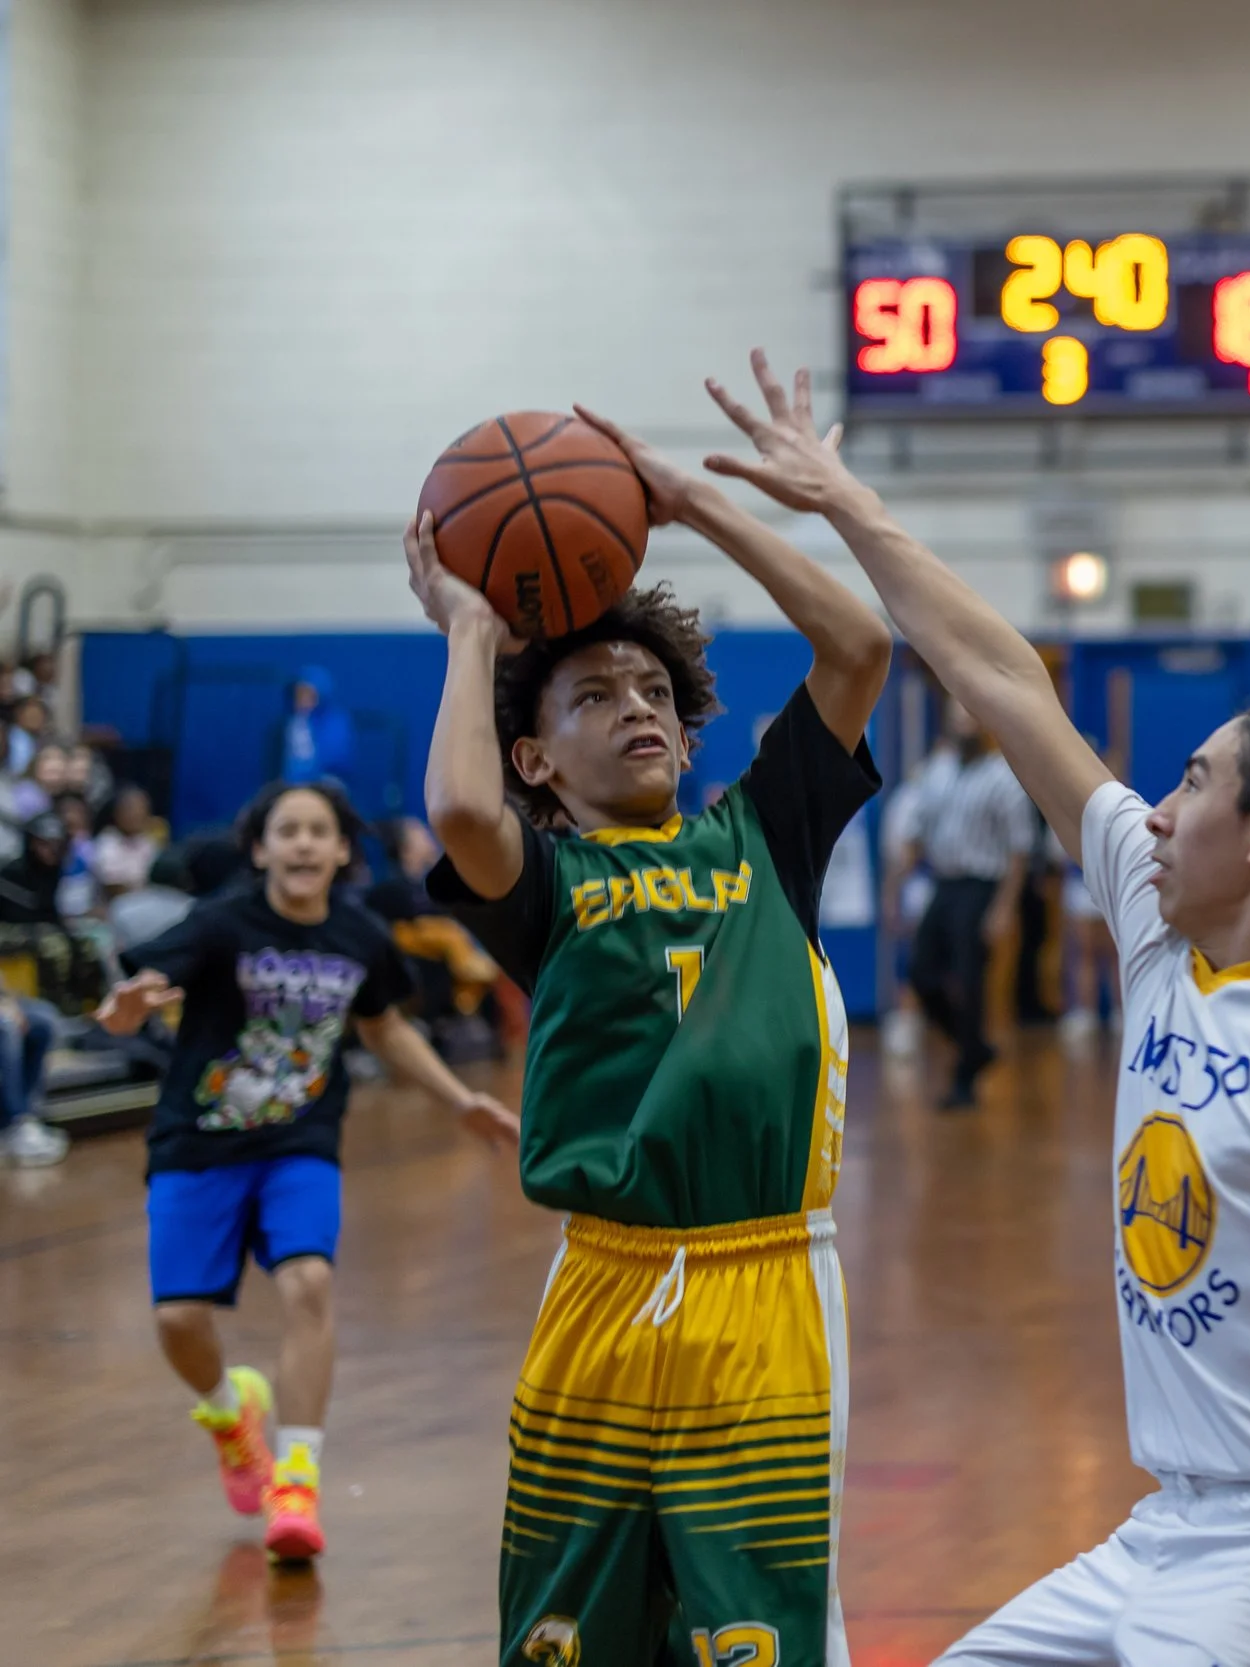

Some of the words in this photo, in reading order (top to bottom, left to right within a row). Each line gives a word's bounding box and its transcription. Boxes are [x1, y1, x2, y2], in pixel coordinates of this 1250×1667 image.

[855, 277, 956, 373] 50
[1042, 336, 1088, 405] 3
[1128, 1016, 1197, 1095] MS
